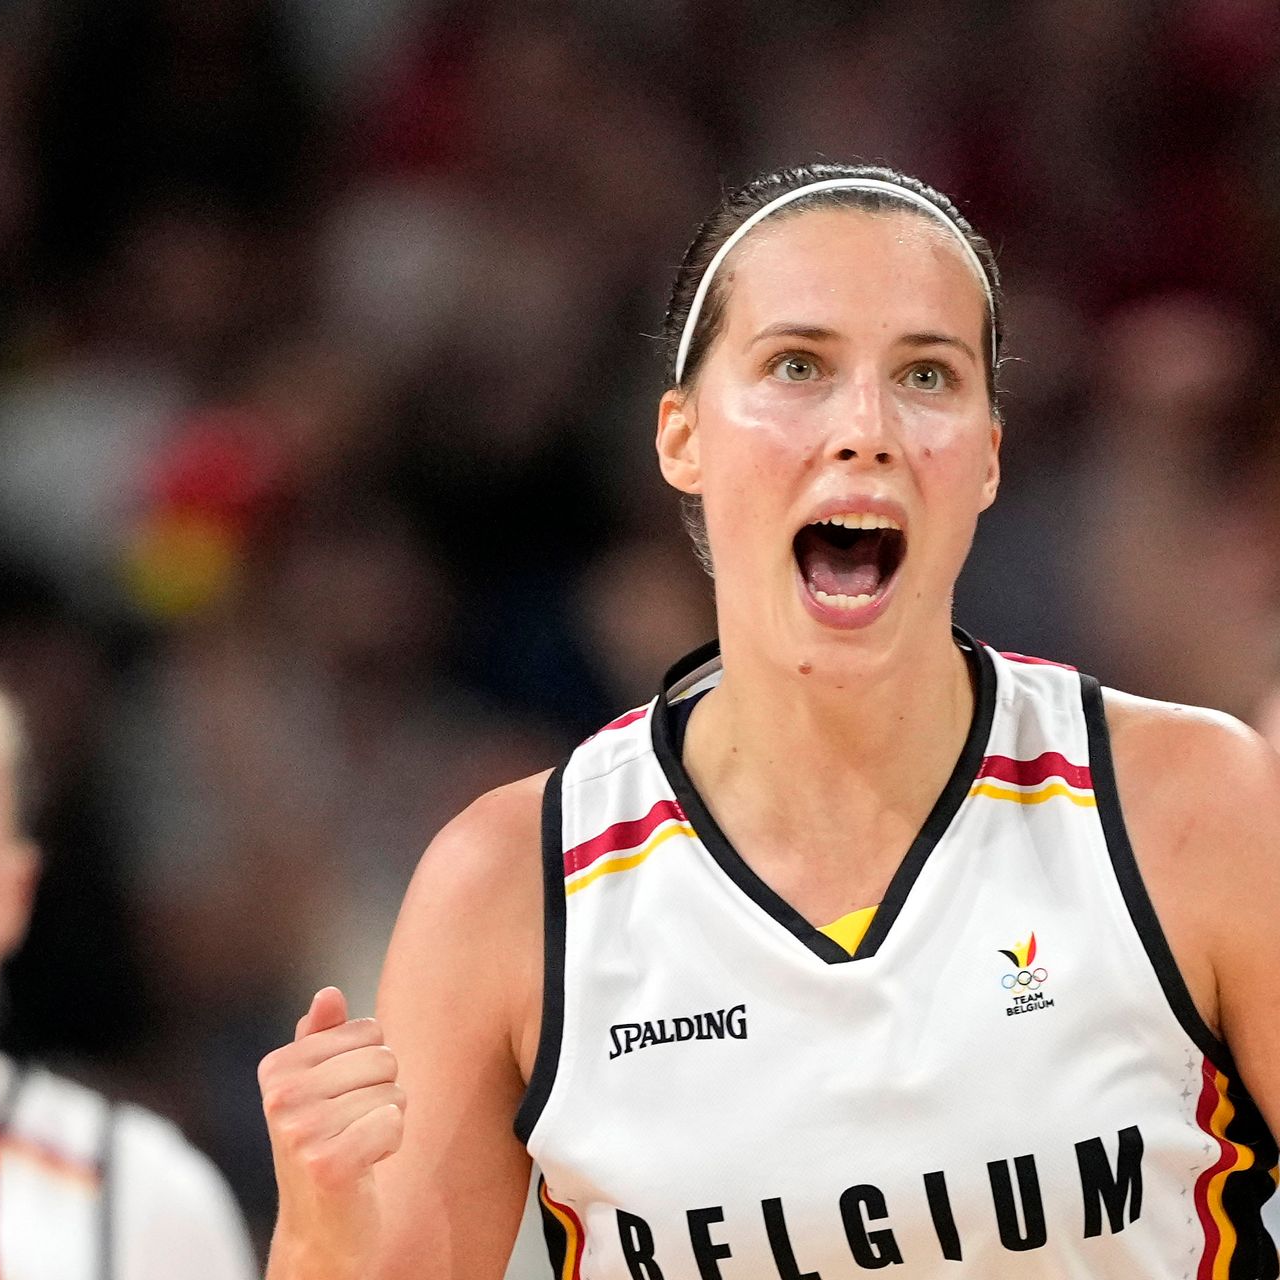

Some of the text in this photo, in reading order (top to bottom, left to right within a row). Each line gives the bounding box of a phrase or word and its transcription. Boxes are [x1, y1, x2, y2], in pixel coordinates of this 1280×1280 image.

[1012, 991, 1044, 1006] TEAM
[1006, 999, 1055, 1017] BELGIUM
[609, 1003, 748, 1060] SPALDING
